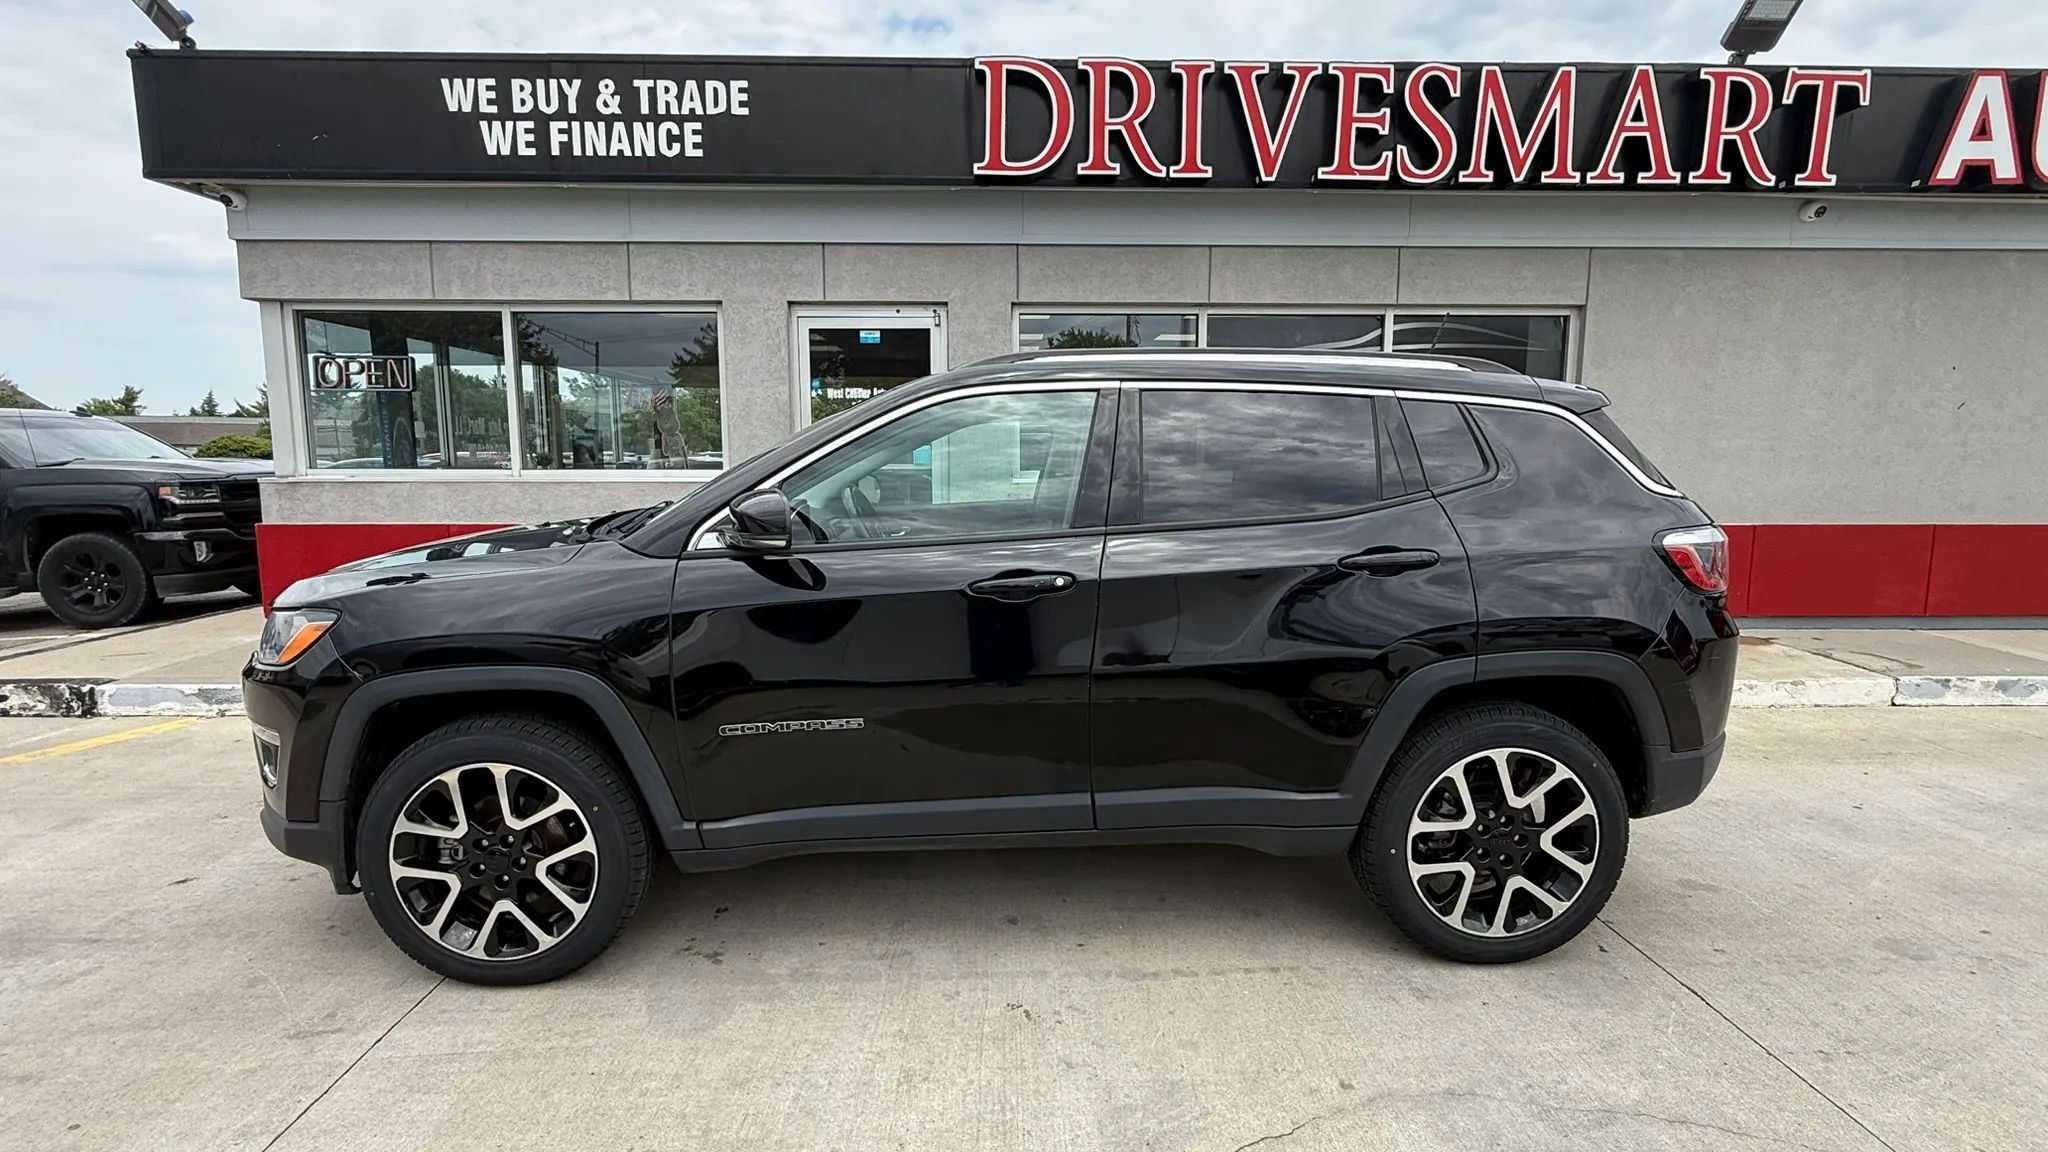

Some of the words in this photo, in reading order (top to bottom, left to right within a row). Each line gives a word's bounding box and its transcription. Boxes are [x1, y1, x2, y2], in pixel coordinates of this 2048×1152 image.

[440, 78, 498, 113] WE
[511, 78, 582, 114] BUY
[596, 78, 622, 115] &
[633, 79, 750, 115] TRADE
[479, 120, 537, 156] WE
[549, 120, 704, 158] FINANCE
[973, 56, 1872, 187] DRIVESMART
[1928, 69, 2048, 185] A
[317, 358, 408, 388] OPEN
[719, 718, 864, 736] COMPASS
